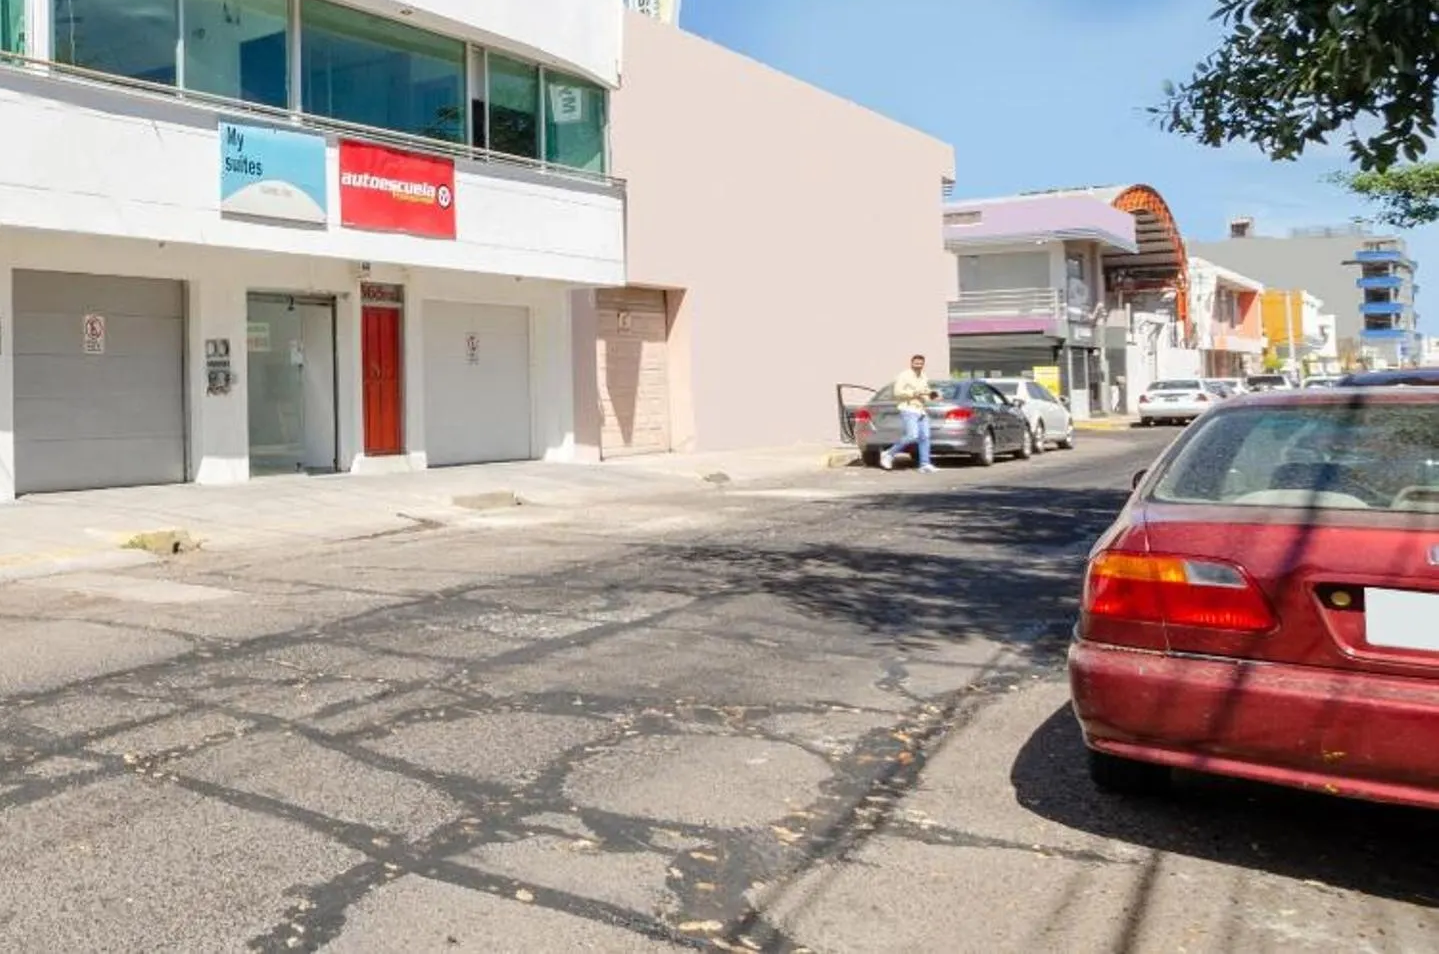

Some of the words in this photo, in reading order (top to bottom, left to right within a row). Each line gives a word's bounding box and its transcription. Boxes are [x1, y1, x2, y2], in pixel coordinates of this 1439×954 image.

[227, 126, 244, 151] My
[225, 156, 263, 176] suites
[341, 172, 436, 197] autoescuela
